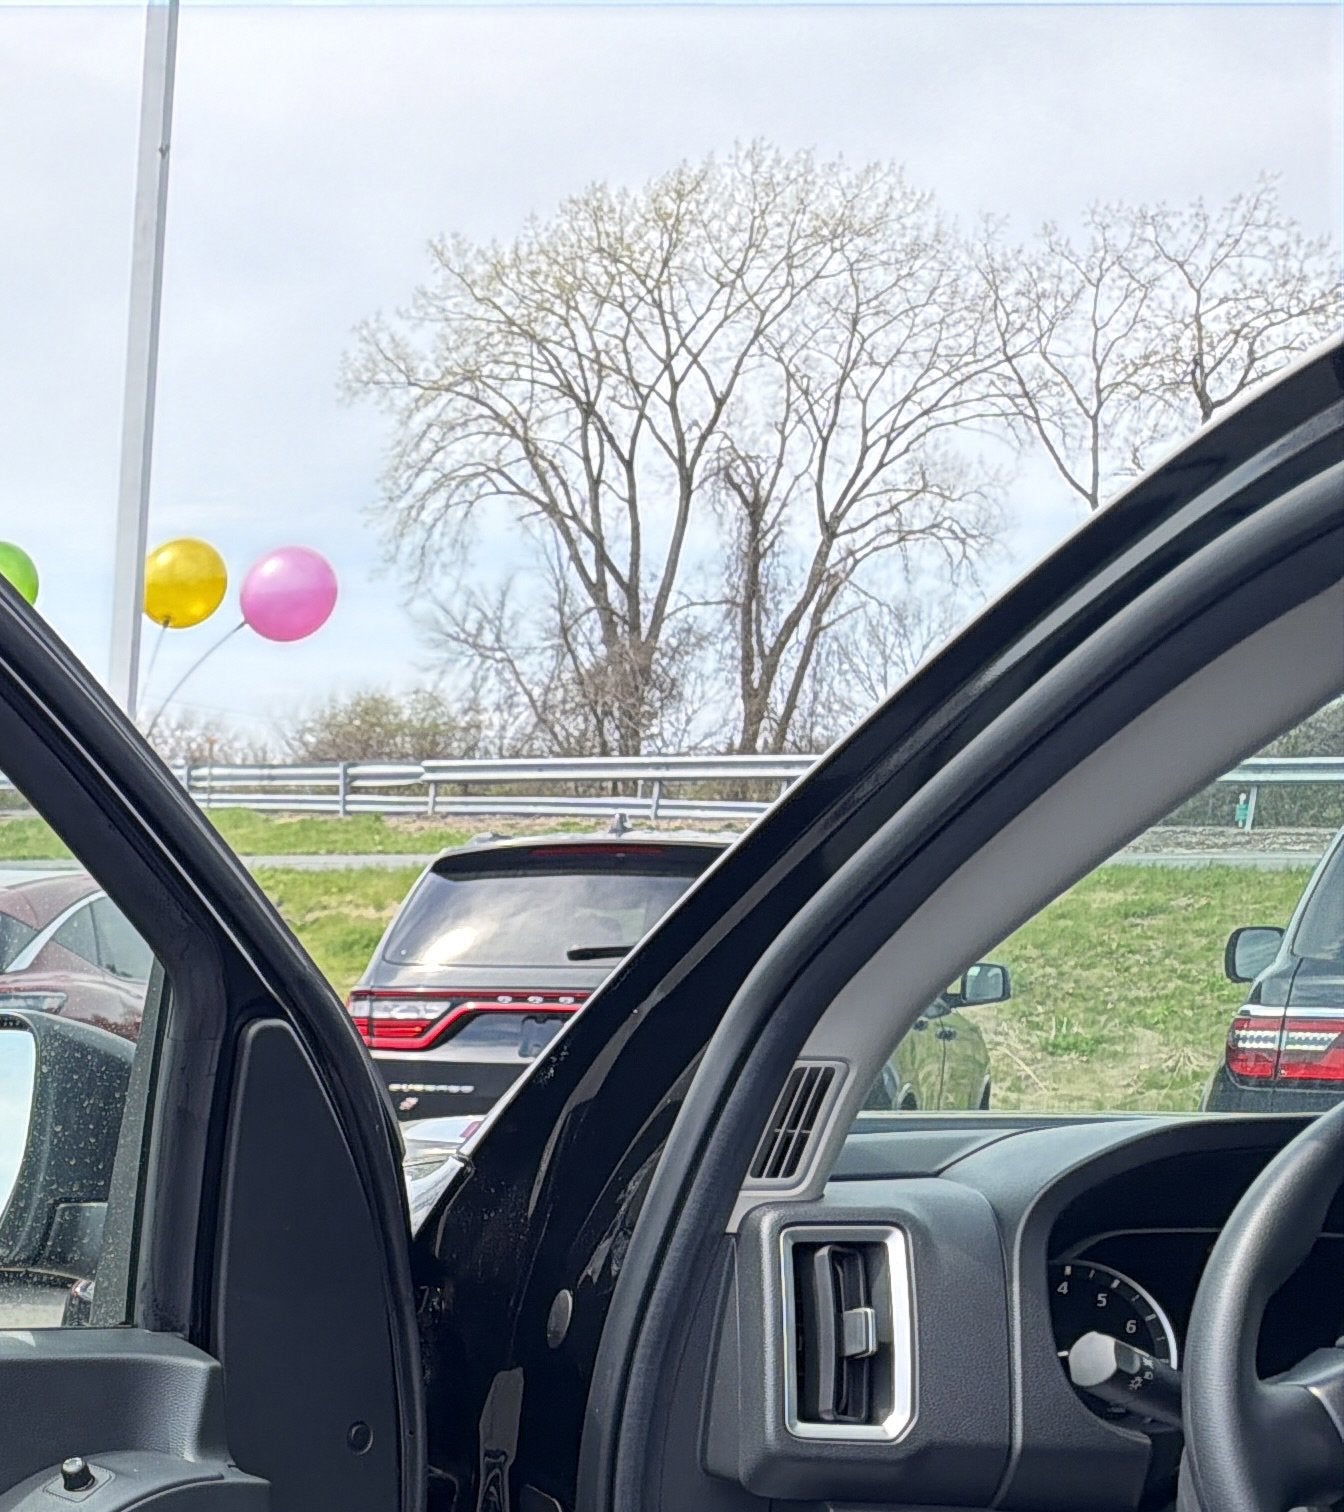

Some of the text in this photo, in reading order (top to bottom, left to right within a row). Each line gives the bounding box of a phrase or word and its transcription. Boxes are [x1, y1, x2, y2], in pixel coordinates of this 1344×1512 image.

[1057, 1281, 1069, 1295] 4
[1096, 1293, 1108, 1307] 5
[1126, 1319, 1137, 1334] 6
